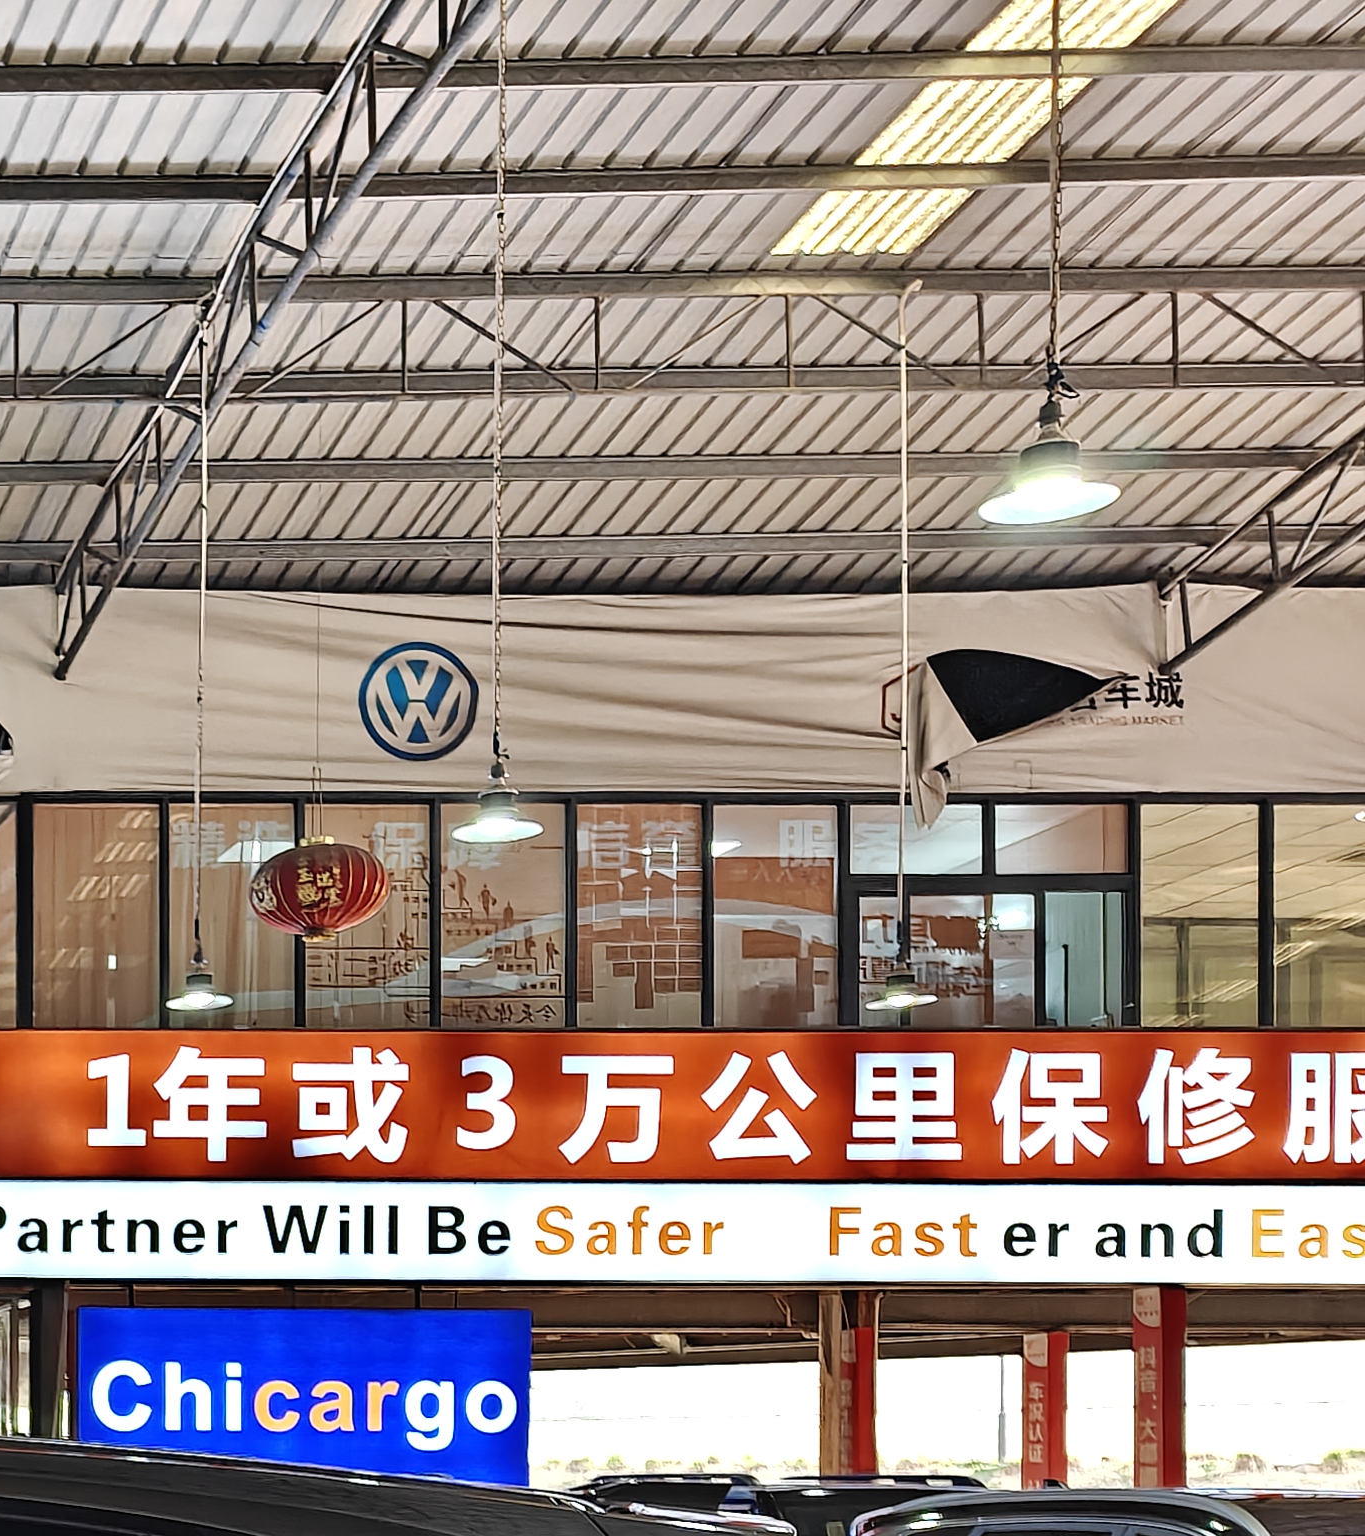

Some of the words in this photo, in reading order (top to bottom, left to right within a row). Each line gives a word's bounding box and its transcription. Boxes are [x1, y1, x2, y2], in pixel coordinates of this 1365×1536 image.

[1070, 671, 1184, 711] 车城
[263, 1205, 398, 1255] Will
[429, 1206, 510, 1256] Be
[535, 1206, 724, 1256] Safer
[1095, 1209, 1223, 1258] and
[91, 1359, 518, 1452] Chicargo
